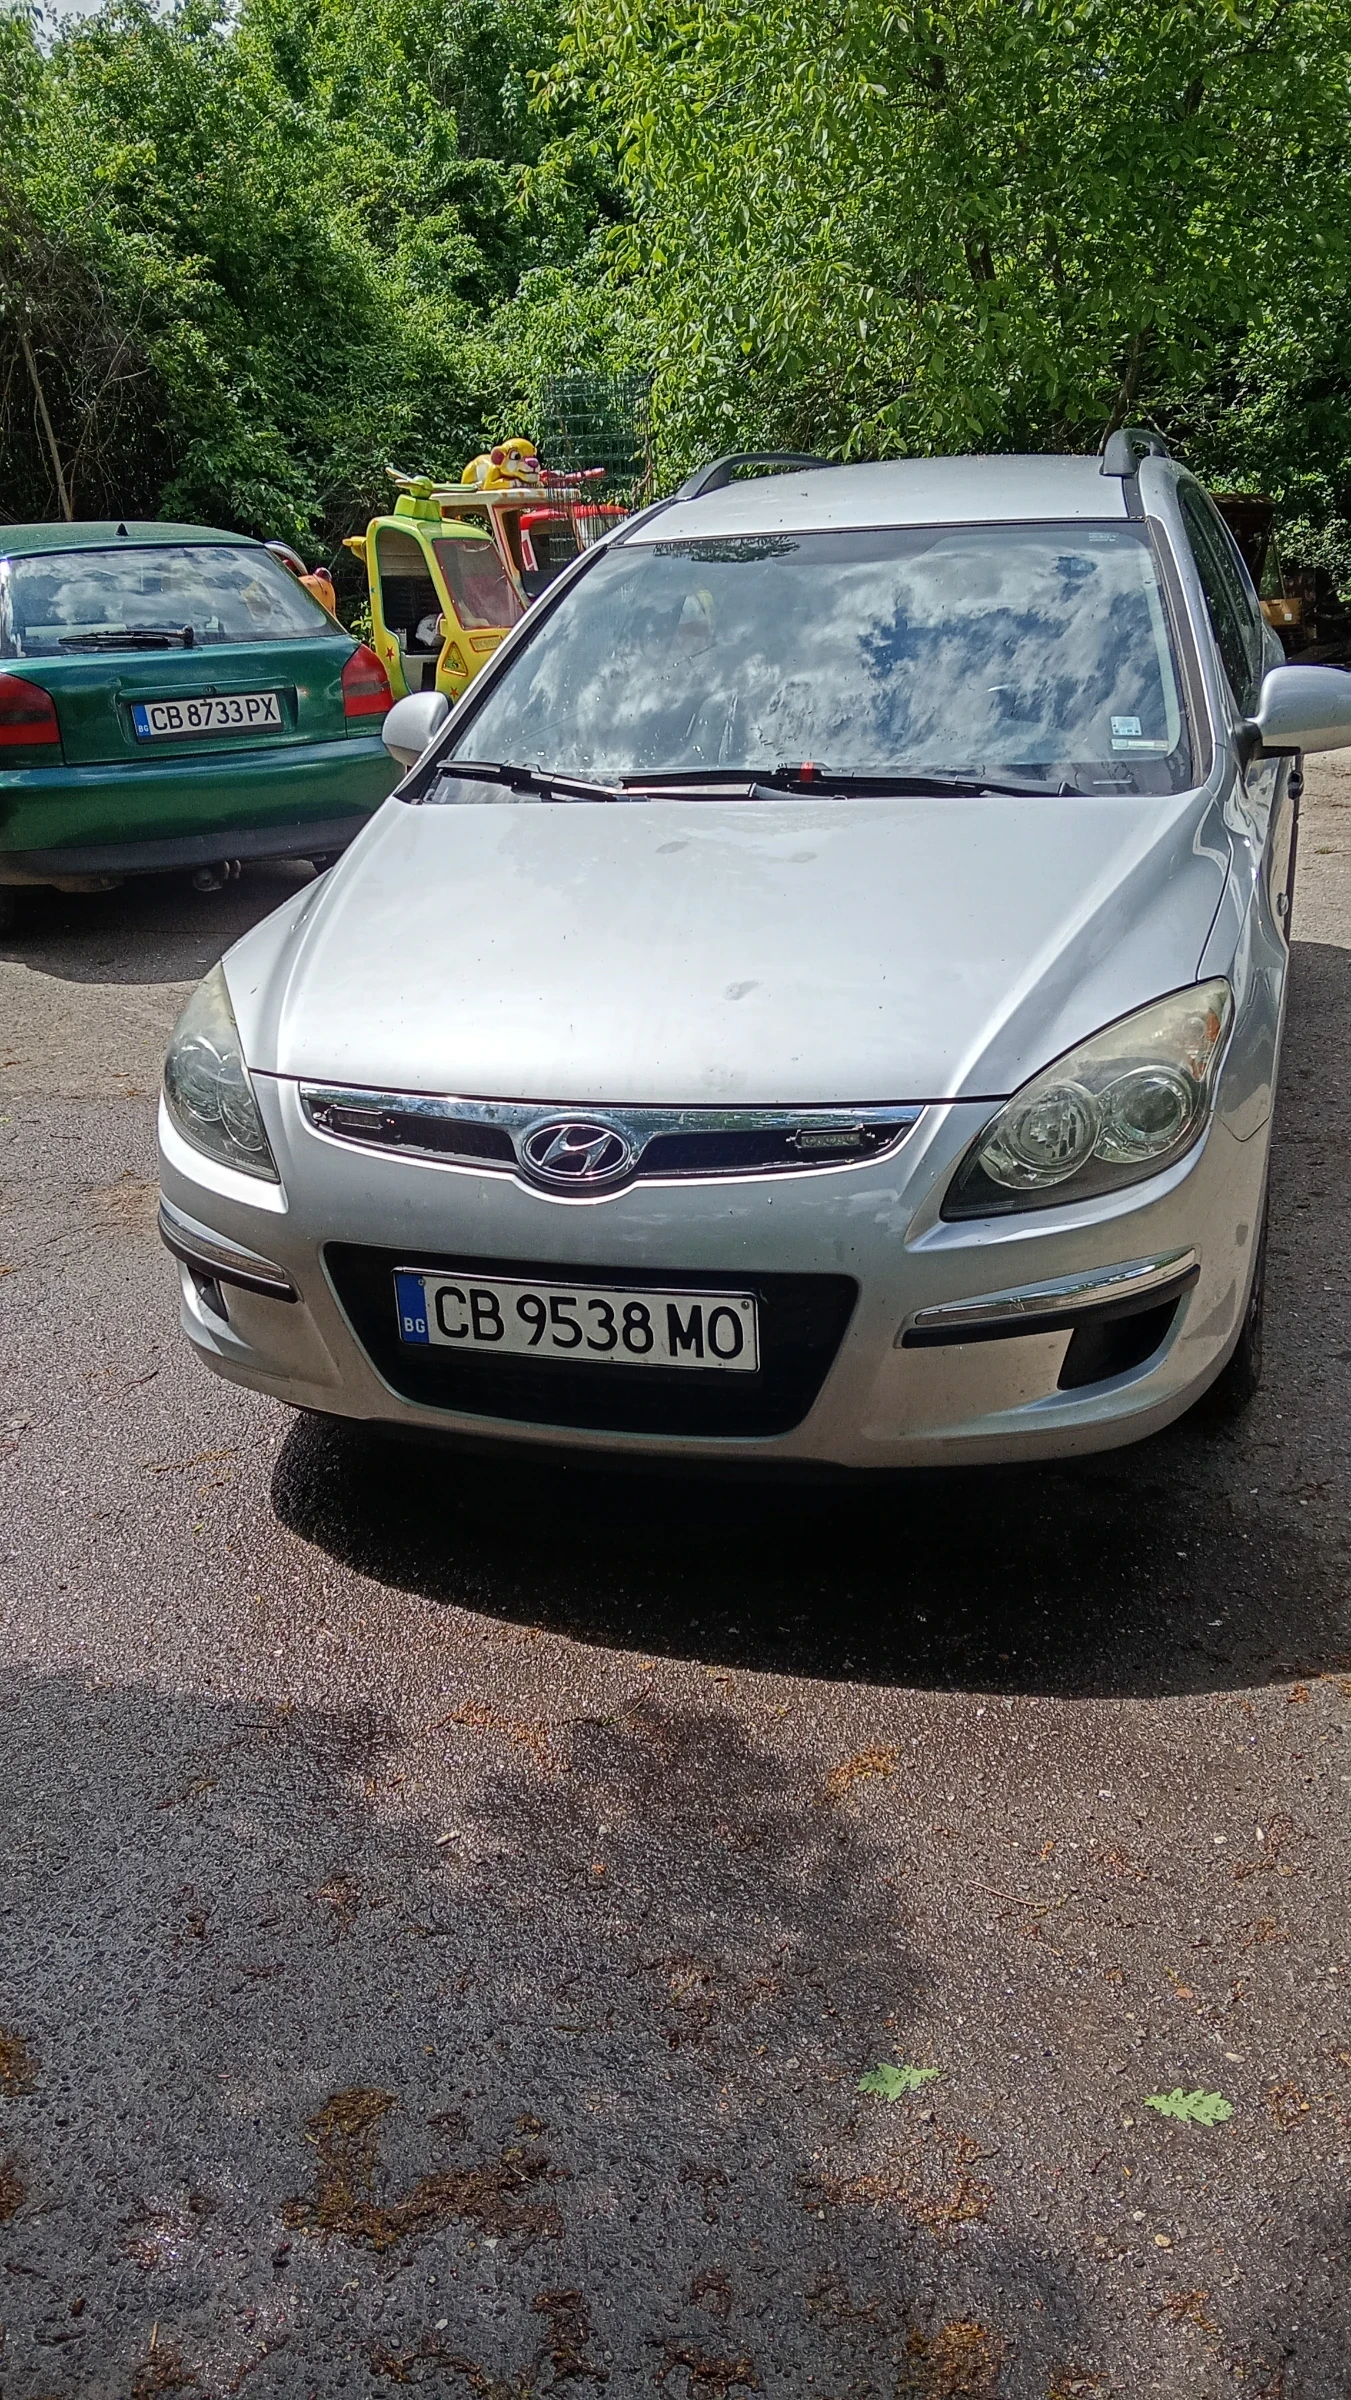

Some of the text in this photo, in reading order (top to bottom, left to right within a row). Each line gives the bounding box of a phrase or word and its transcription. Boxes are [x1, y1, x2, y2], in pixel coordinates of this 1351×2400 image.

[151, 697, 277, 731] CB 8733 PX
[138, 724, 149, 733] BG
[403, 1317, 426, 1334] BG
[434, 1286, 744, 1359] CB 9538 MO
